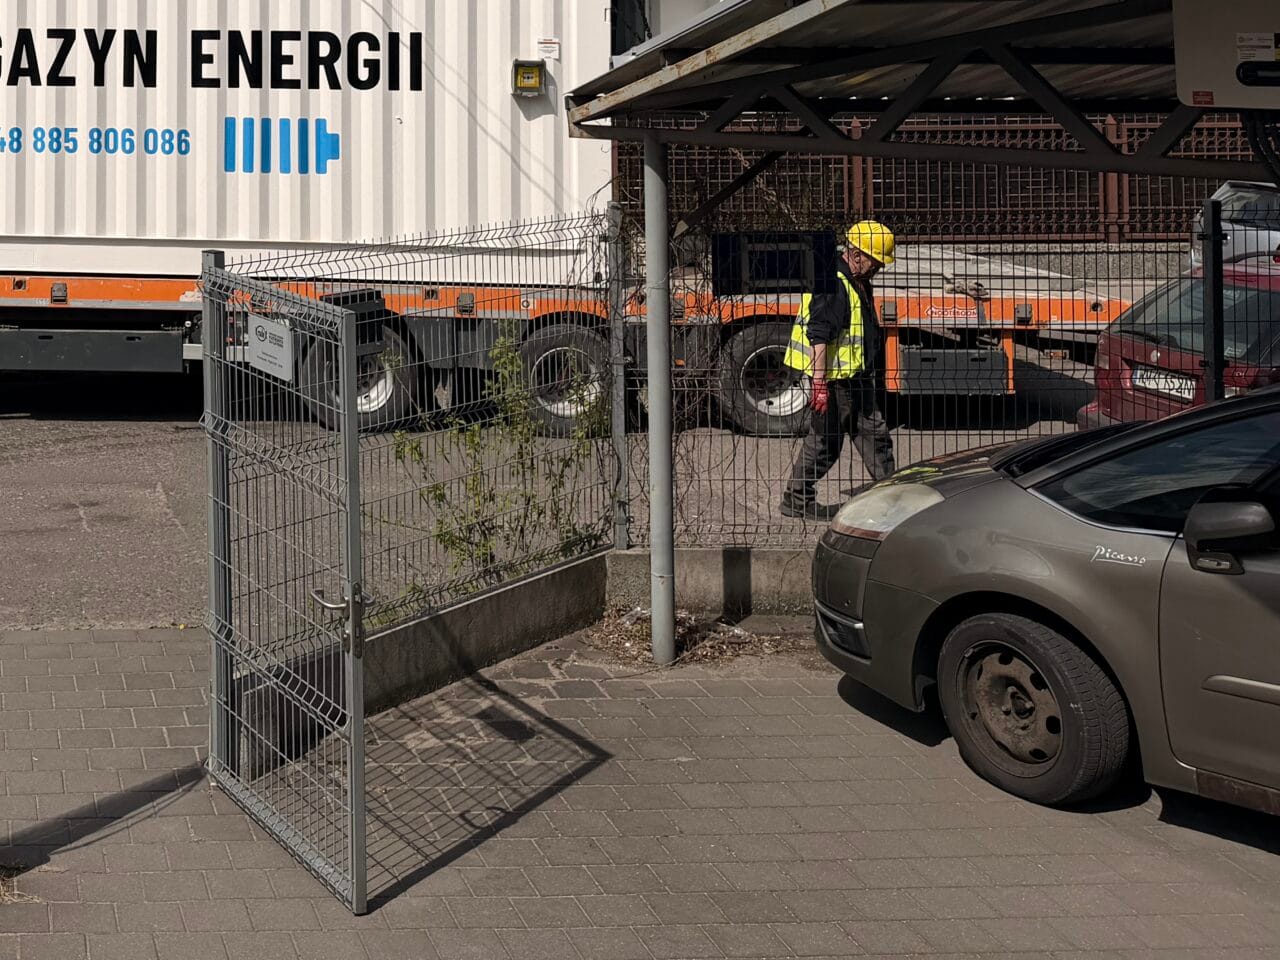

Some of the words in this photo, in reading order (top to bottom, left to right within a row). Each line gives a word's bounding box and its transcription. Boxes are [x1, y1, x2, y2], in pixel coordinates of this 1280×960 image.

[191, 30, 423, 91] ENERGII
[32, 126, 79, 154] 885
[88, 127, 135, 155] 806
[143, 128, 191, 156] 086
